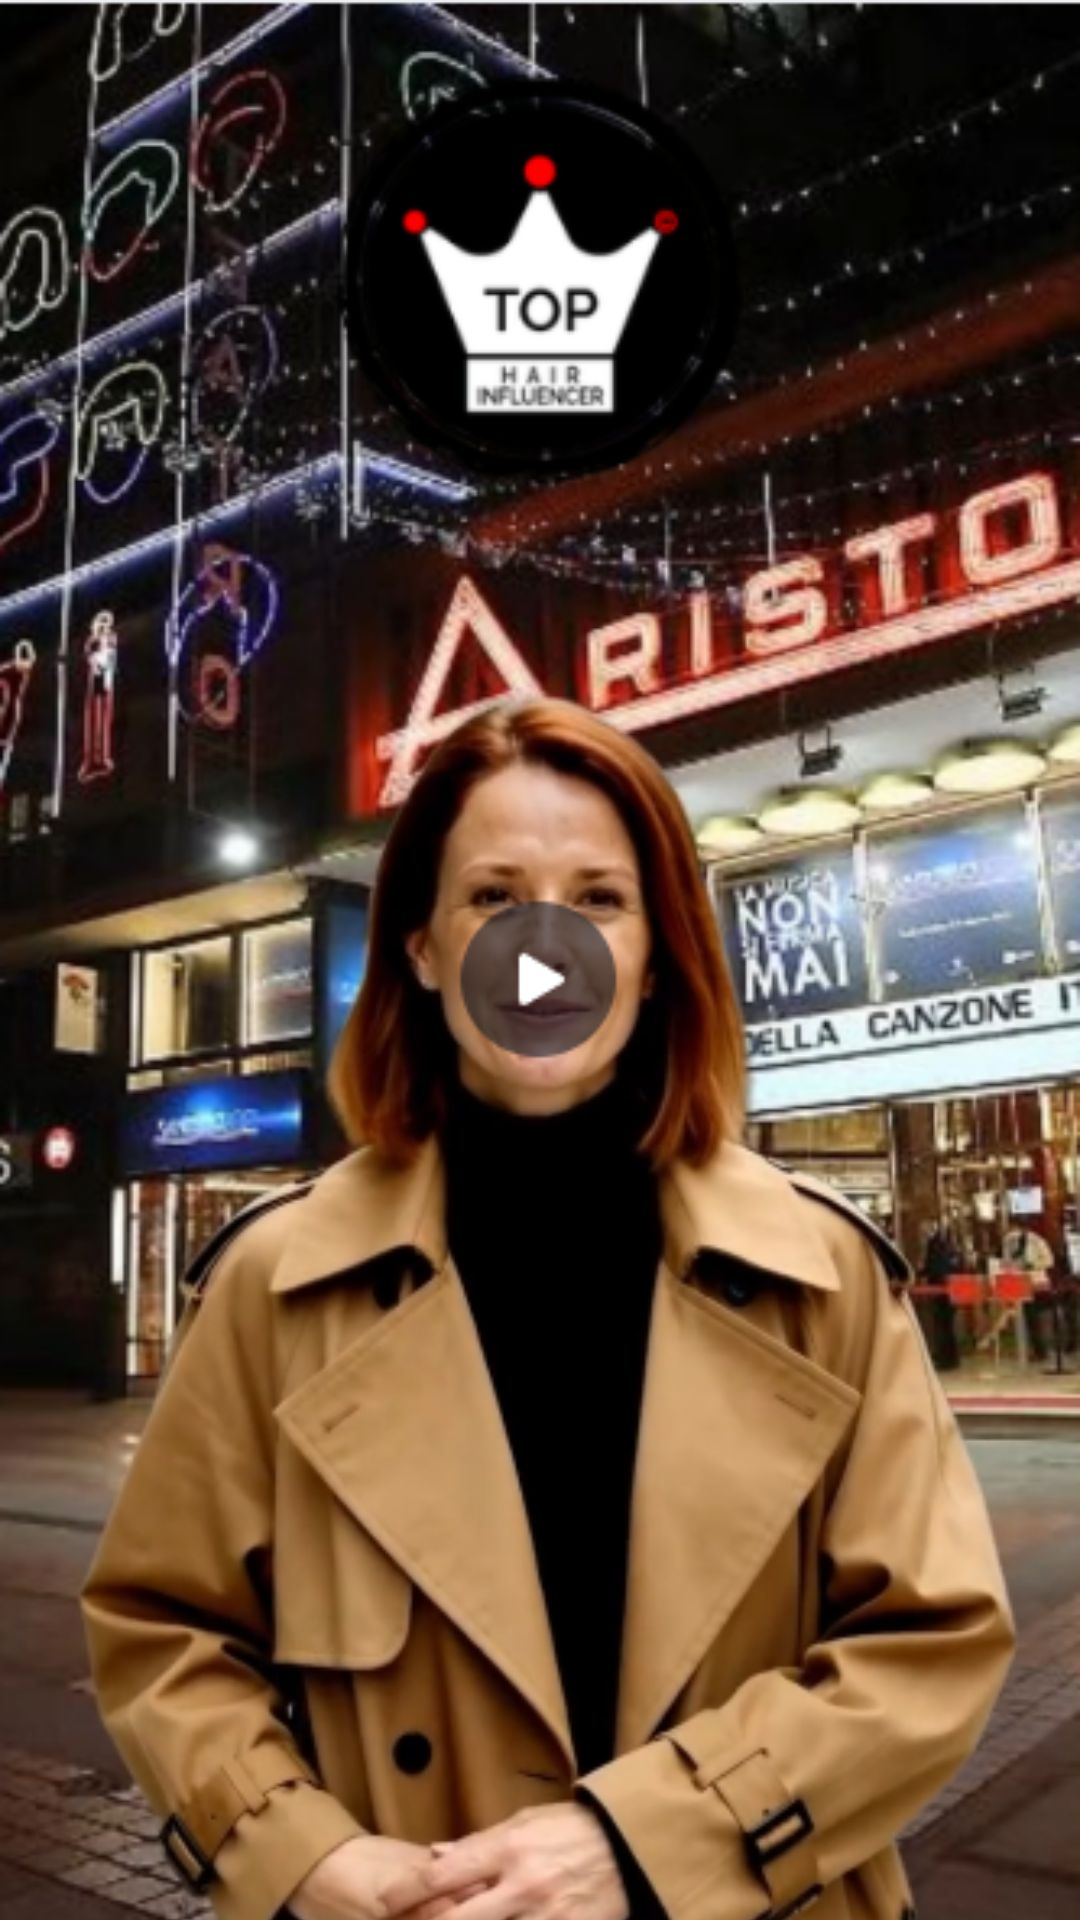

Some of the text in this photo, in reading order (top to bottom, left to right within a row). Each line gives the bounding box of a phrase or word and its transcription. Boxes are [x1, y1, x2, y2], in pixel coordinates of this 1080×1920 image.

[377, 472, 1061, 808] ARISTO
[736, 886, 839, 939] NON
[745, 939, 849, 1003] MAI
[868, 989, 1033, 1039] CANZONE
